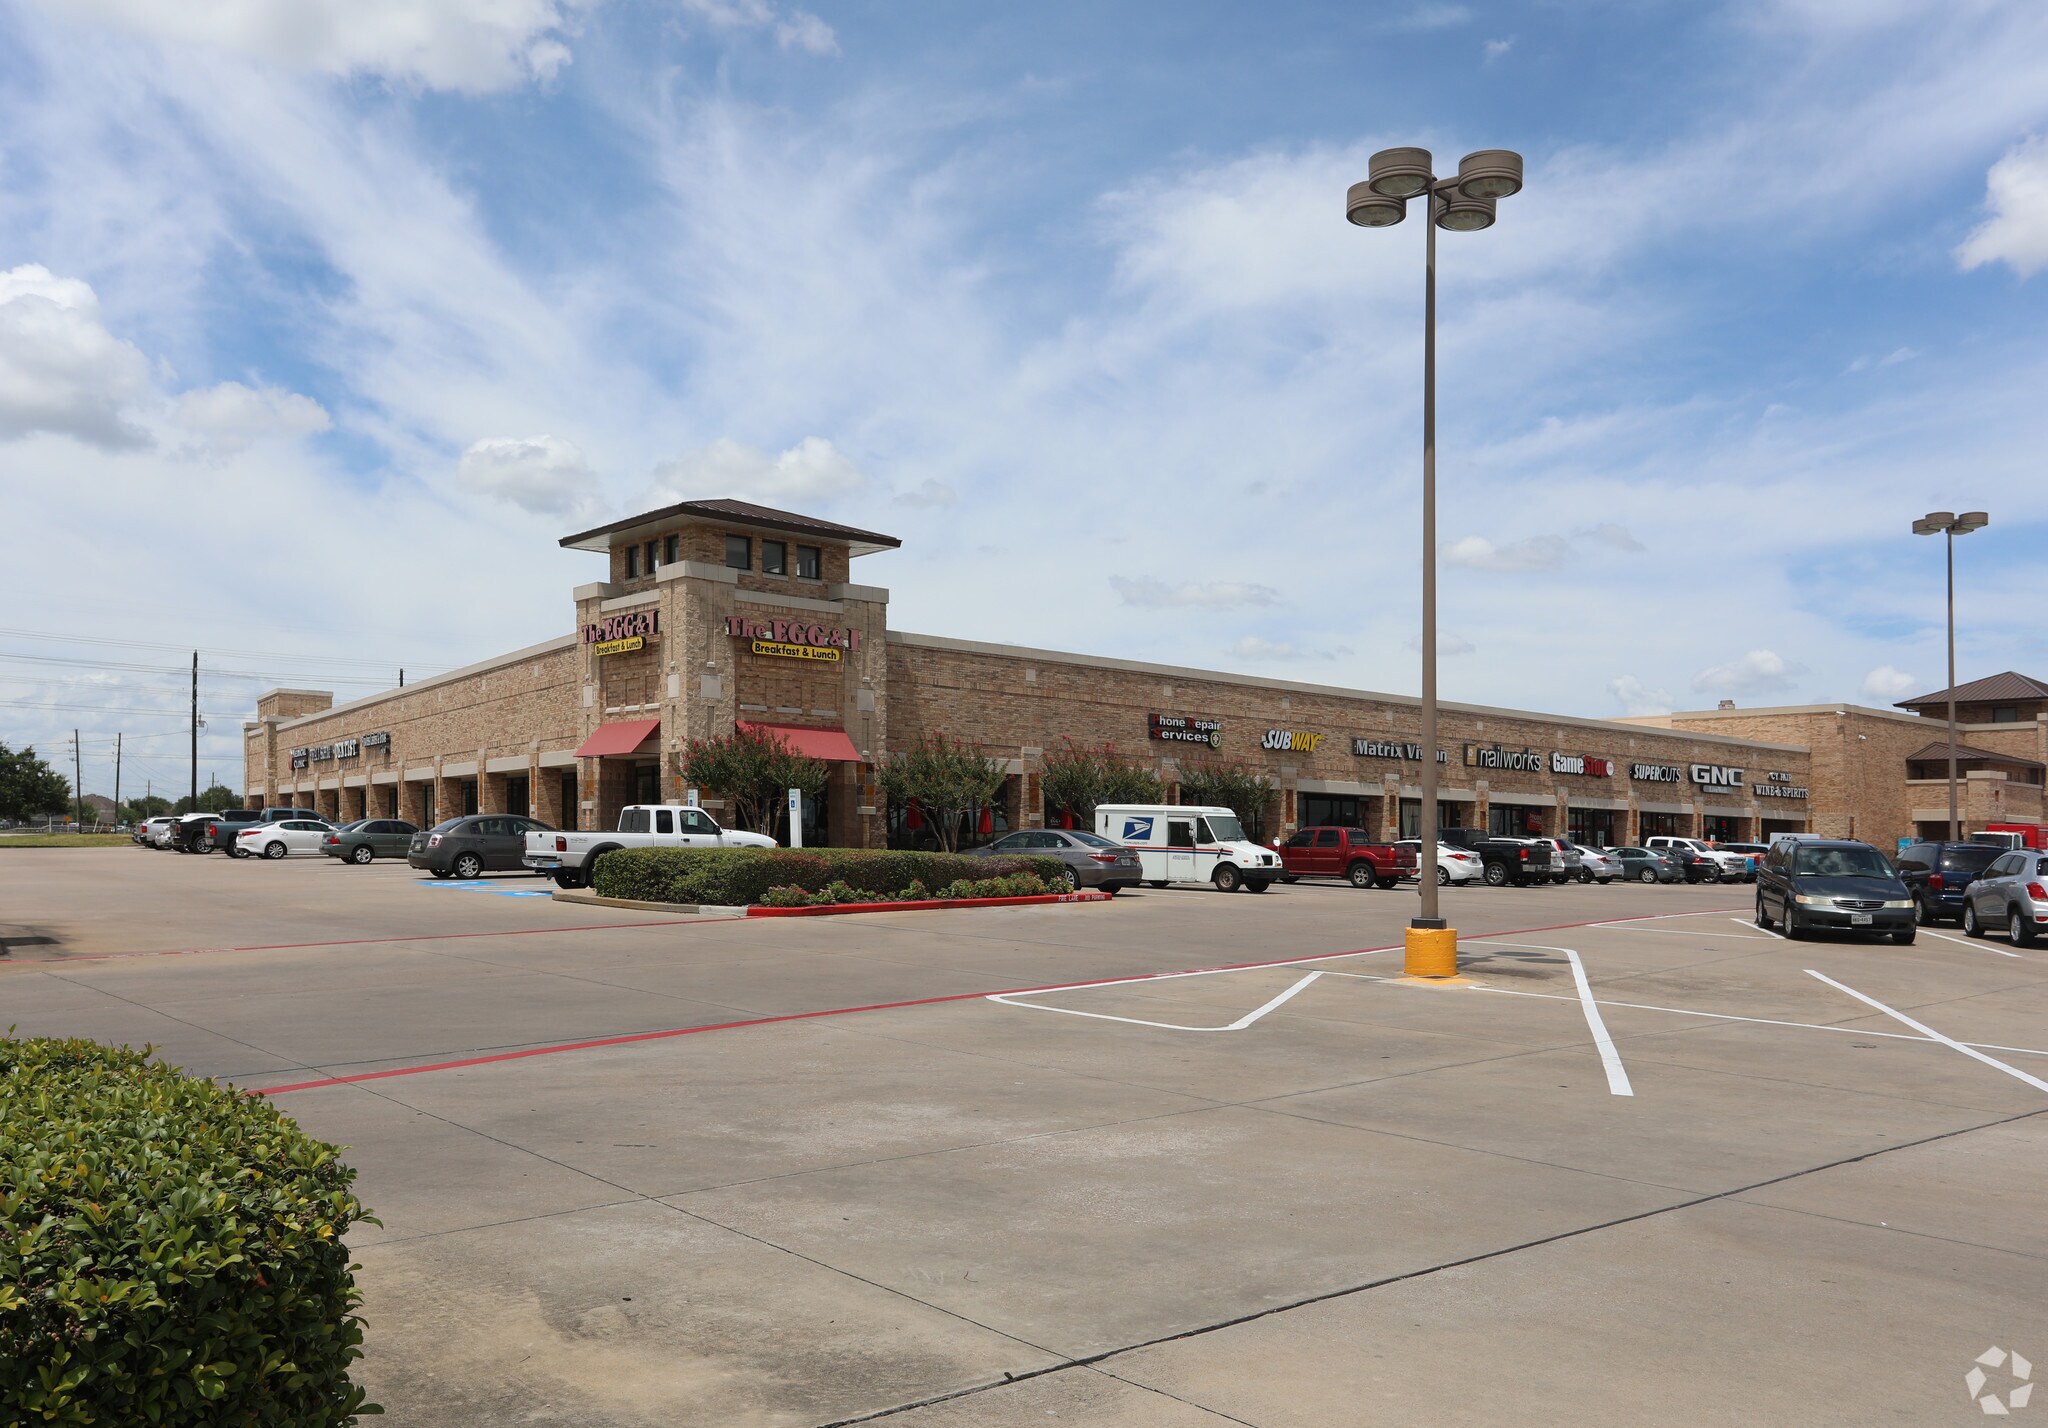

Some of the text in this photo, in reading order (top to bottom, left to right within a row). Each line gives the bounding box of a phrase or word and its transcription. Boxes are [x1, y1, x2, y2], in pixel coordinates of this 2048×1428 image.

[582, 624, 601, 644] The
[603, 614, 634, 641] EGG
[726, 616, 860, 652] The EGG & I
[596, 641, 620, 655] Breakfast
[626, 639, 641, 650] Lunch
[755, 642, 837, 660] Breakfast & Lunch
[1151, 713, 1221, 731] Phone Repair
[1153, 727, 1209, 743] Services
[1263, 730, 1323, 751] SUBWAY
[1356, 740, 1403, 758] Matrix
[1480, 747, 1541, 772] nailworks
[1553, 752, 1608, 777] GameStop
[1634, 764, 1681, 782] SUPERCUTS
[1692, 764, 1744, 787] GNC
[1770, 772, 1792, 782] CY FAIR
[1782, 787, 1810, 799] SPIRITS
